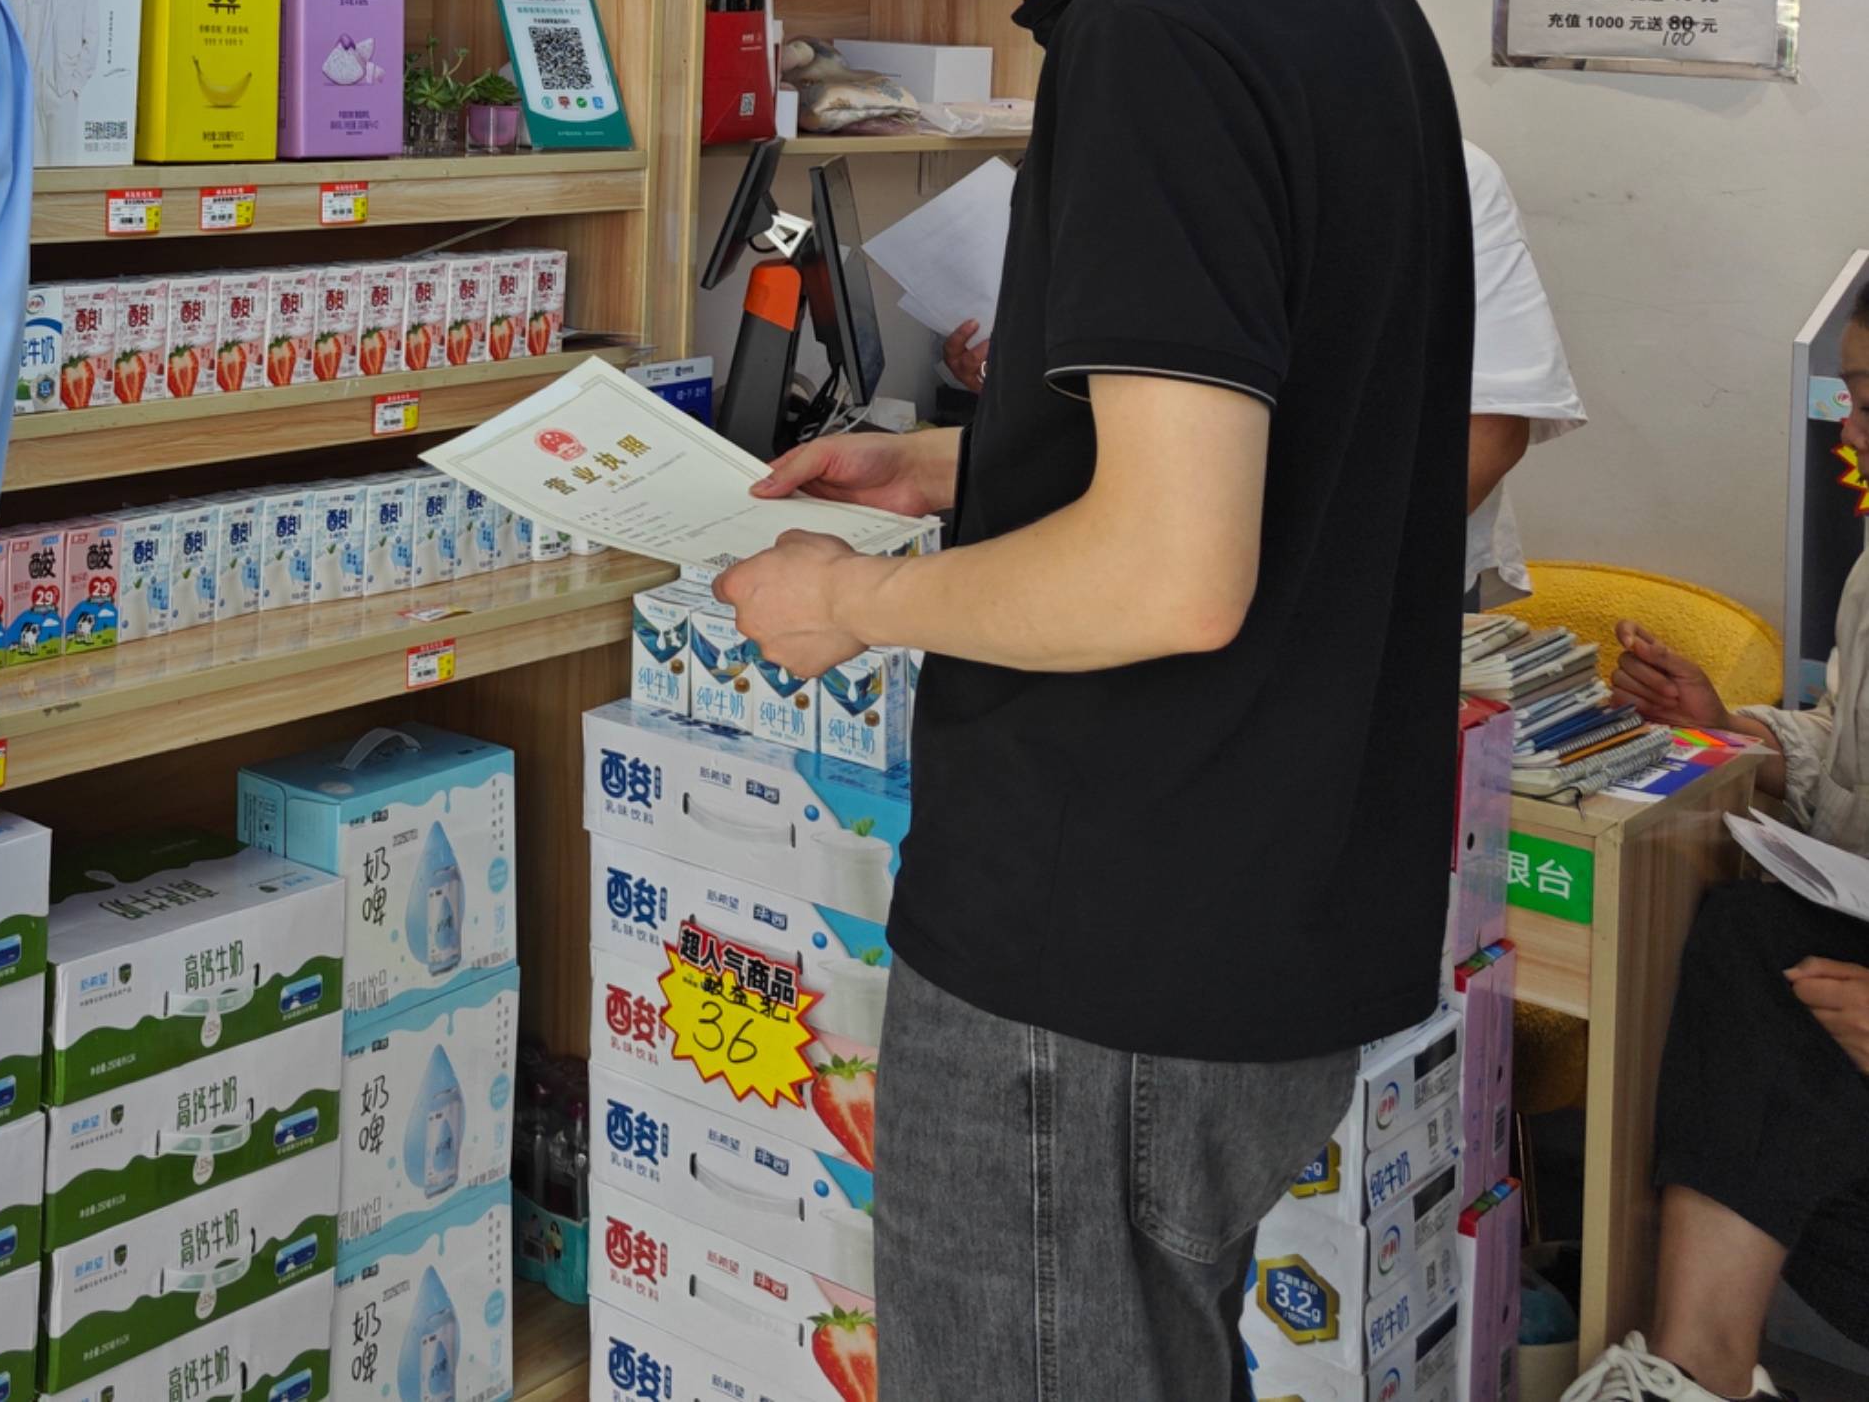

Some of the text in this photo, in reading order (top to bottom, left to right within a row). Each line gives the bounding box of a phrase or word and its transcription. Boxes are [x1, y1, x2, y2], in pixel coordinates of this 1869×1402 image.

[1547, 13, 1581, 29] 充值
[1587, 15, 1624, 29] 1000
[1630, 15, 1663, 32] 元送
[1701, 17, 1718, 34] 元
[1663, 28, 1696, 47] 100
[543, 434, 651, 495] 营业执照
[33, 588, 56, 608] 29
[91, 578, 112, 600] 29
[638, 667, 680, 702] 纯牛奶
[696, 686, 746, 720] 纯牛奶
[760, 701, 807, 737] 纯牛奶
[828, 717, 877, 754] 纯牛奶
[184, 939, 245, 994] 高钙牛奶
[681, 929, 794, 1004] 超人气商品
[693, 1002, 757, 1063] 36
[176, 1076, 239, 1130] 高钙牛奶
[606, 1098, 659, 1167] 酸
[706, 1127, 742, 1151] 新希望
[179, 1209, 240, 1265] 高钙牛奶
[605, 1214, 659, 1285] 酸
[706, 1250, 740, 1274] 新希望
[1274, 1282, 1323, 1324] 3.2g
